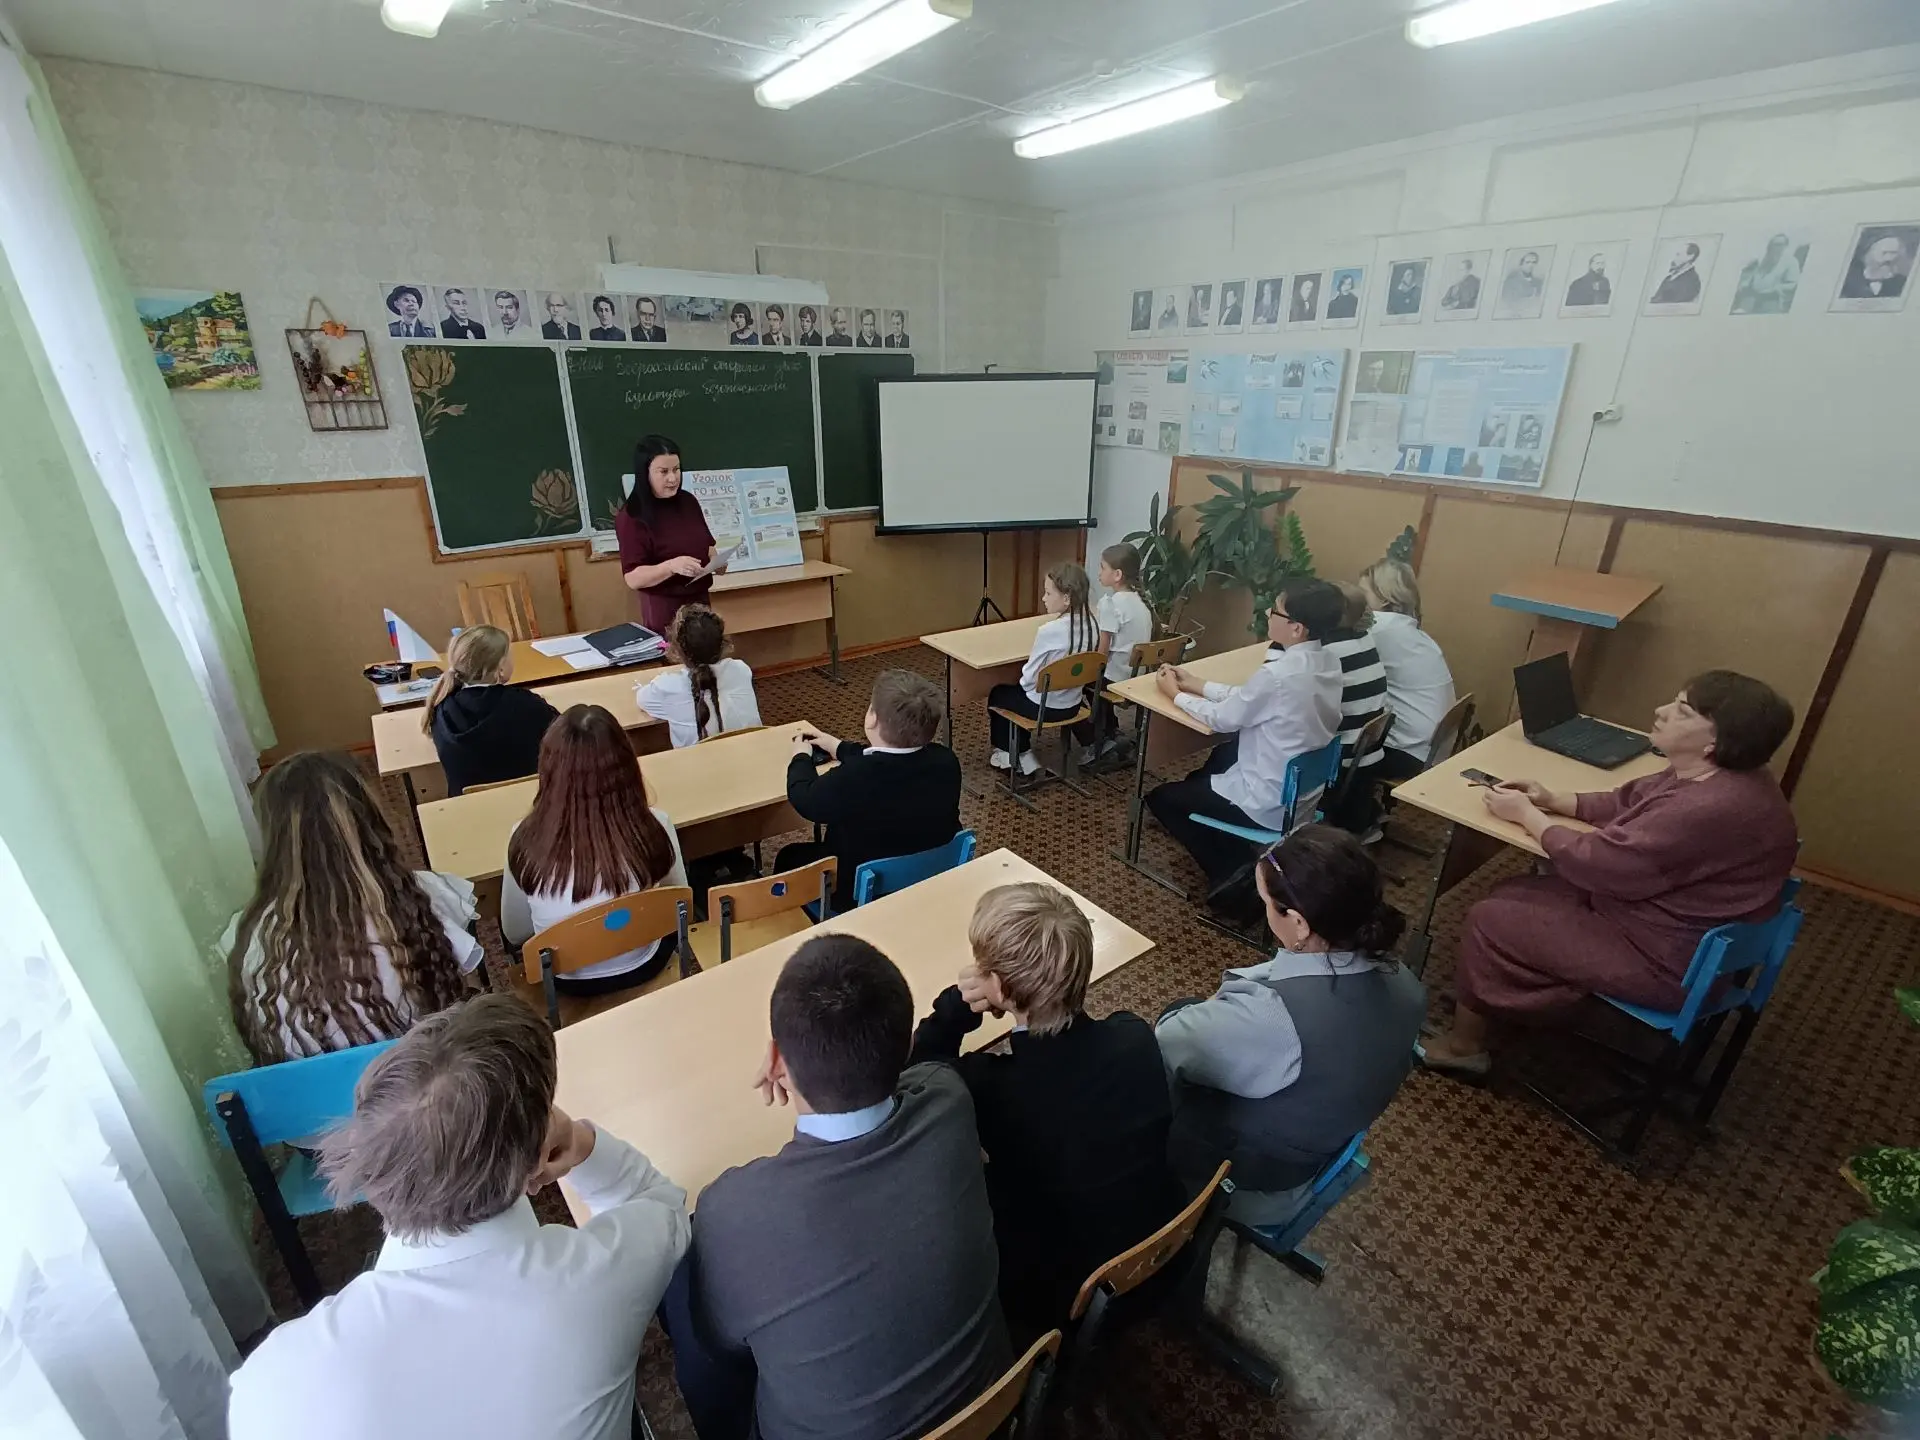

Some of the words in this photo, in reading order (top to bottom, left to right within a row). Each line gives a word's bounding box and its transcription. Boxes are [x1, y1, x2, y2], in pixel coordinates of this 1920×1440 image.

[692, 473, 733, 484] Уголок
[693, 487, 708, 496] ГО
[720, 485, 734, 494] ЧС
